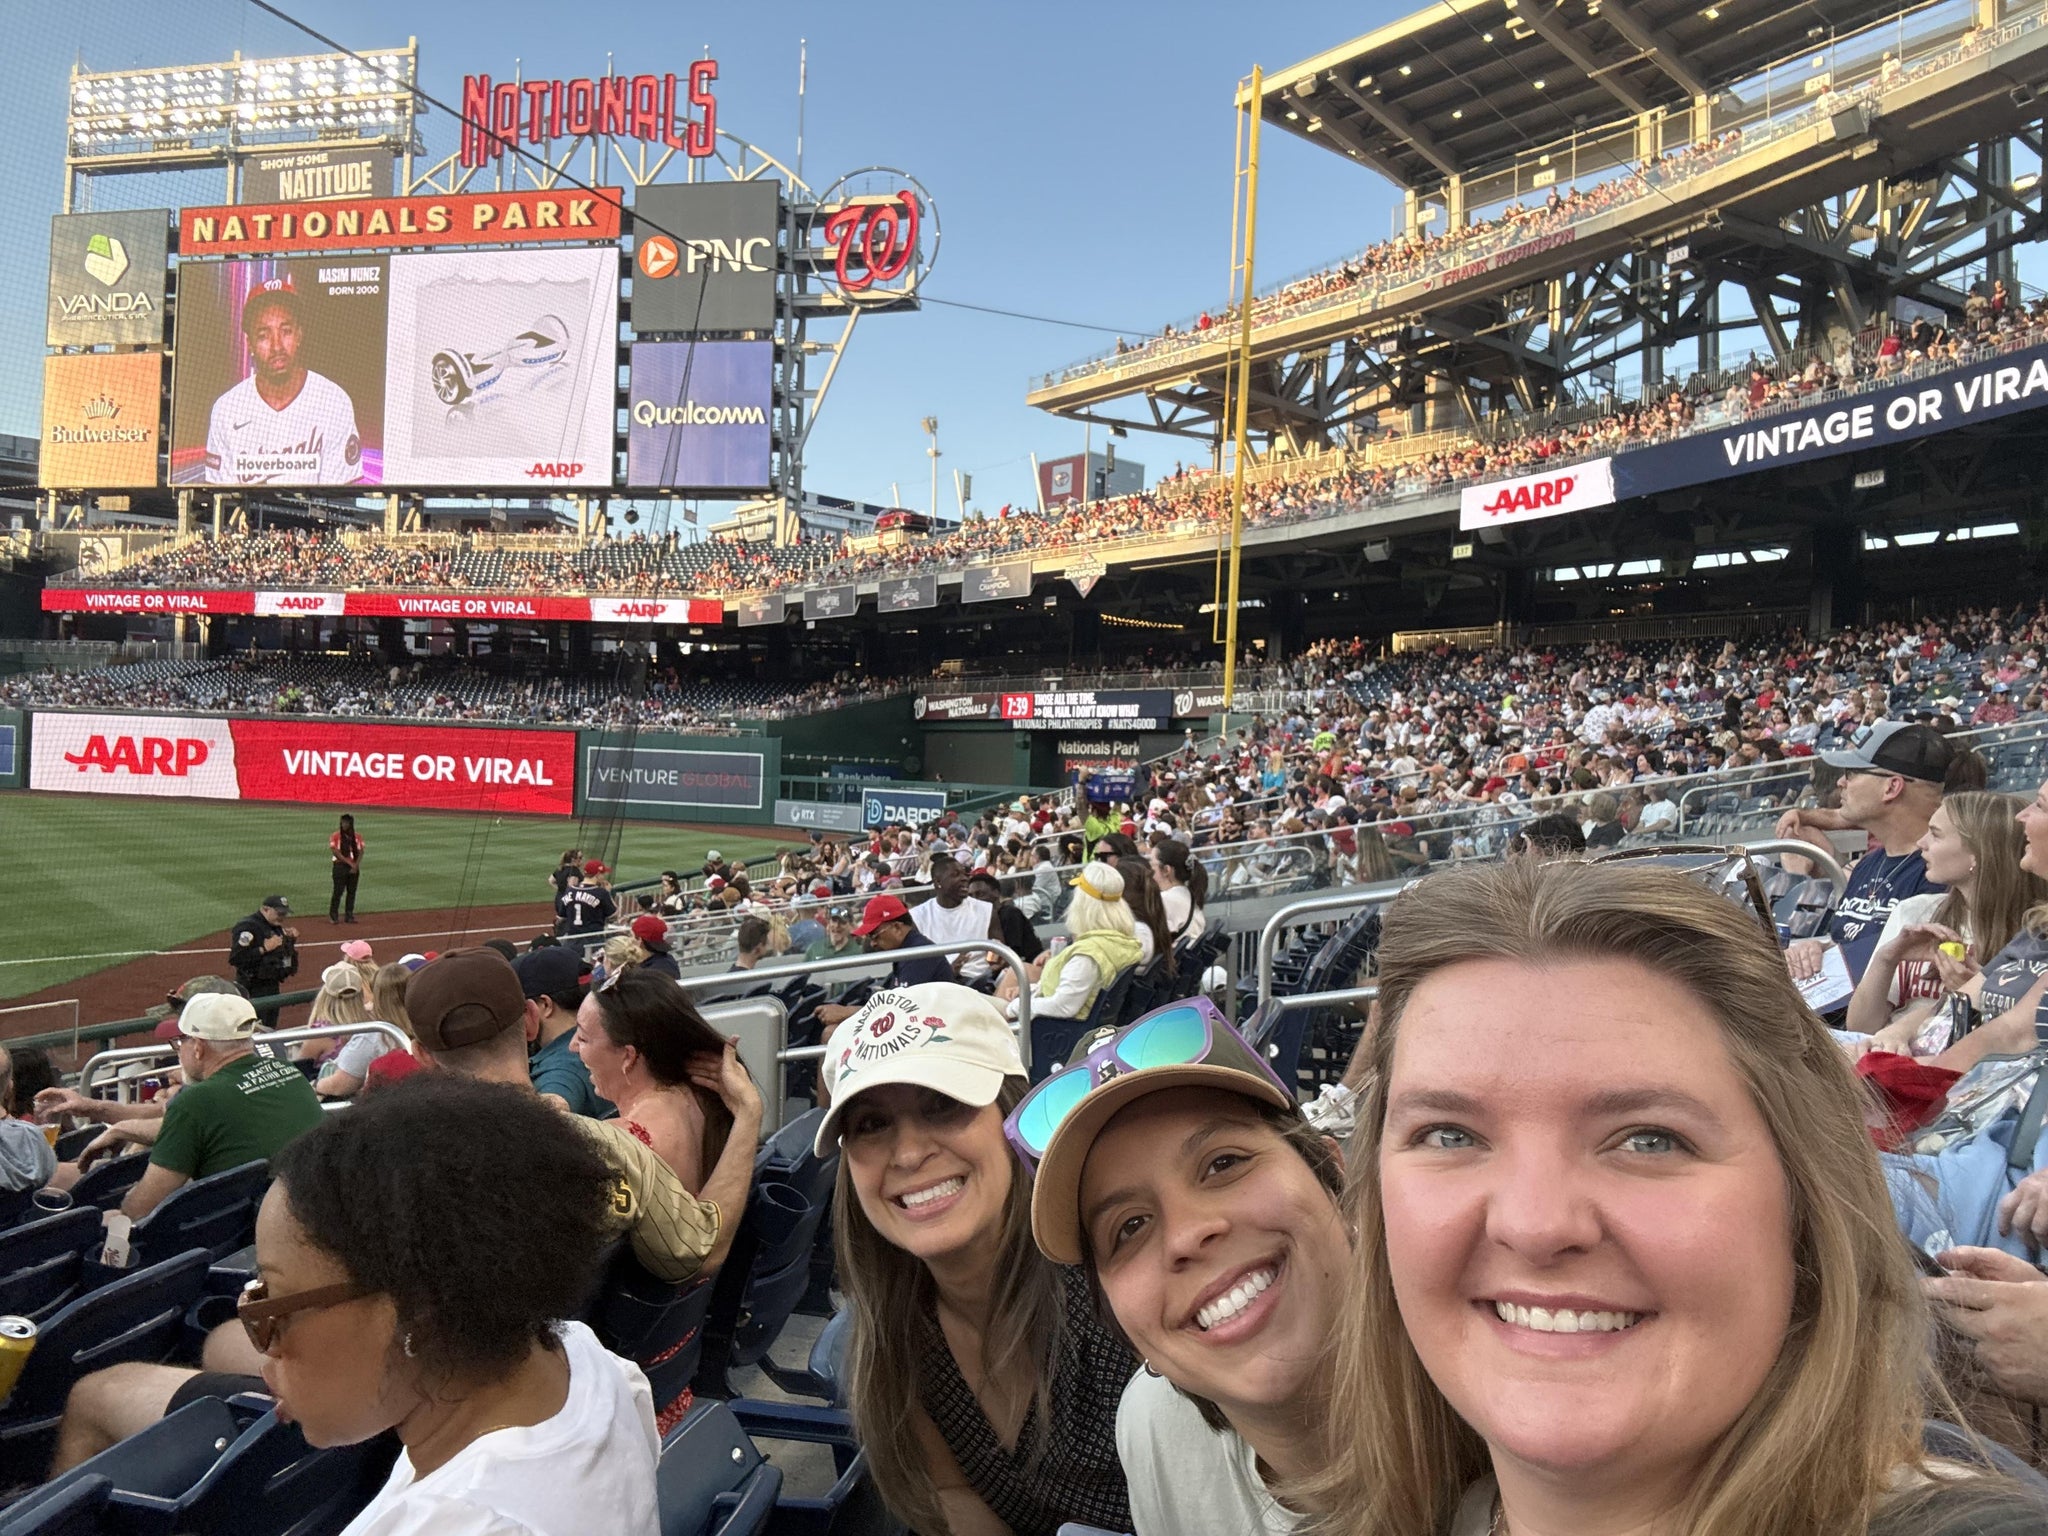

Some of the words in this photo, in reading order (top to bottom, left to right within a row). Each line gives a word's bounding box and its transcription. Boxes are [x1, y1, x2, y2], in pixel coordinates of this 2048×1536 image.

[460, 59, 718, 168] NATIONALS
[260, 156, 295, 171] SHOW
[296, 152, 329, 166] SOME
[279, 160, 373, 200] NATITUDE
[193, 205, 449, 242] NATIONALS
[472, 199, 594, 231] PARK
[686, 237, 772, 274] PNC
[318, 268, 349, 283] NASIM
[329, 286, 355, 295] BORN
[356, 285, 380, 295] 2000
[57, 291, 152, 314] VANDA
[633, 400, 766, 428] Qualcomm
[1723, 404, 1874, 467] VINTAGE
[1886, 388, 1943, 431] OR
[1954, 358, 2048, 414] VIRA
[51, 425, 150, 444] Budweiser
[236, 457, 317, 471] Hoverboard
[525, 463, 584, 478] AARP
[1484, 475, 1574, 516] AARP
[85, 594, 141, 608] VINTAGE
[143, 594, 165, 609] OR
[167, 595, 208, 609] VIRAL
[276, 597, 325, 610] AARP
[398, 599, 461, 613] VINTAGE
[464, 600, 487, 614] OR
[489, 600, 536, 615] VIRAL
[613, 603, 666, 617] AARP
[928, 696, 973, 712] WASHINGTON
[1007, 697, 1029, 716] 7:39
[1034, 693, 1054, 705] THOSE
[1054, 693, 1065, 705] ALL
[1066, 692, 1079, 705] THE
[948, 703, 988, 718] NATIONALS
[1076, 705, 1096, 717] DON'T
[1096, 705, 1118, 717] KNOW
[1118, 704, 1140, 717] WHAT
[1013, 719, 1047, 729] NATIONALS
[1048, 718, 1102, 729] PHILANTHROPIES
[1108, 718, 1157, 729] #NATS4GOOD
[64, 735, 209, 777] AARP
[1057, 740, 1111, 755] Nationals
[1112, 741, 1140, 756] Park
[283, 749, 405, 779] VINTAGE
[412, 754, 456, 782] OR
[464, 757, 553, 786] VIRAL
[598, 768, 679, 786] VENTURE
[682, 772, 752, 789] GLOBAL
[801, 808, 816, 821] RTX
[574, 903, 583, 926] 1
[853, 992, 920, 1037] WASHINGTON
[855, 1024, 921, 1062] NATIONALS
[242, 1063, 273, 1080] TEACH
